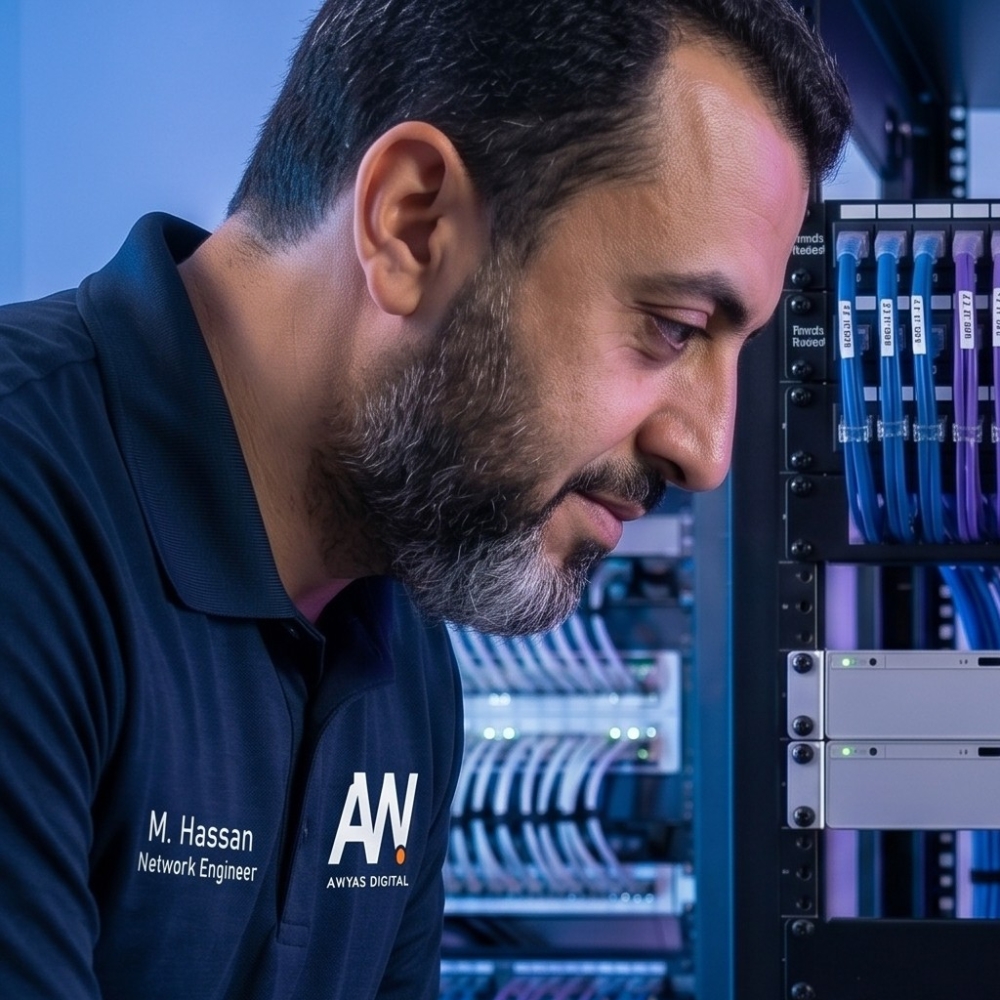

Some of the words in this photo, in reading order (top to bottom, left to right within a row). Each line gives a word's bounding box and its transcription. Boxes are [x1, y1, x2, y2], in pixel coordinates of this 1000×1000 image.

[148, 810, 171, 844] M.
[180, 814, 254, 852] Hassan
[137, 851, 196, 877] Network
[199, 857, 258, 885] Engineer
[327, 876, 367, 889] AWYAS
[370, 874, 410, 888] DIGITAL
